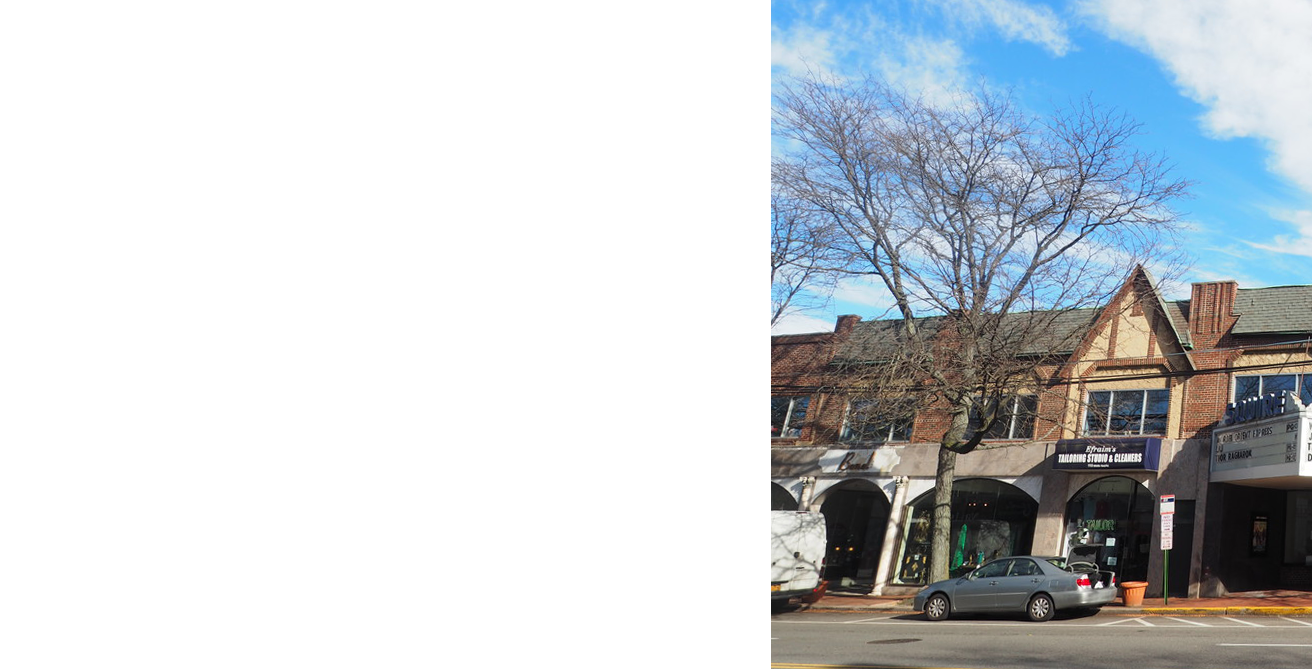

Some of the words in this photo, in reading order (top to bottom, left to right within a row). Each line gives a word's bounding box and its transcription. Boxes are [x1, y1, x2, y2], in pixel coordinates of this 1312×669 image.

[1225, 390, 1287, 424] SQUIRE
[1085, 445, 1116, 454] Efraim's
[1058, 453, 1086, 463] TAILORING
[1087, 453, 1108, 463] STUDIO
[1108, 454, 1113, 463] &
[1114, 453, 1142, 463] CLEANERS
